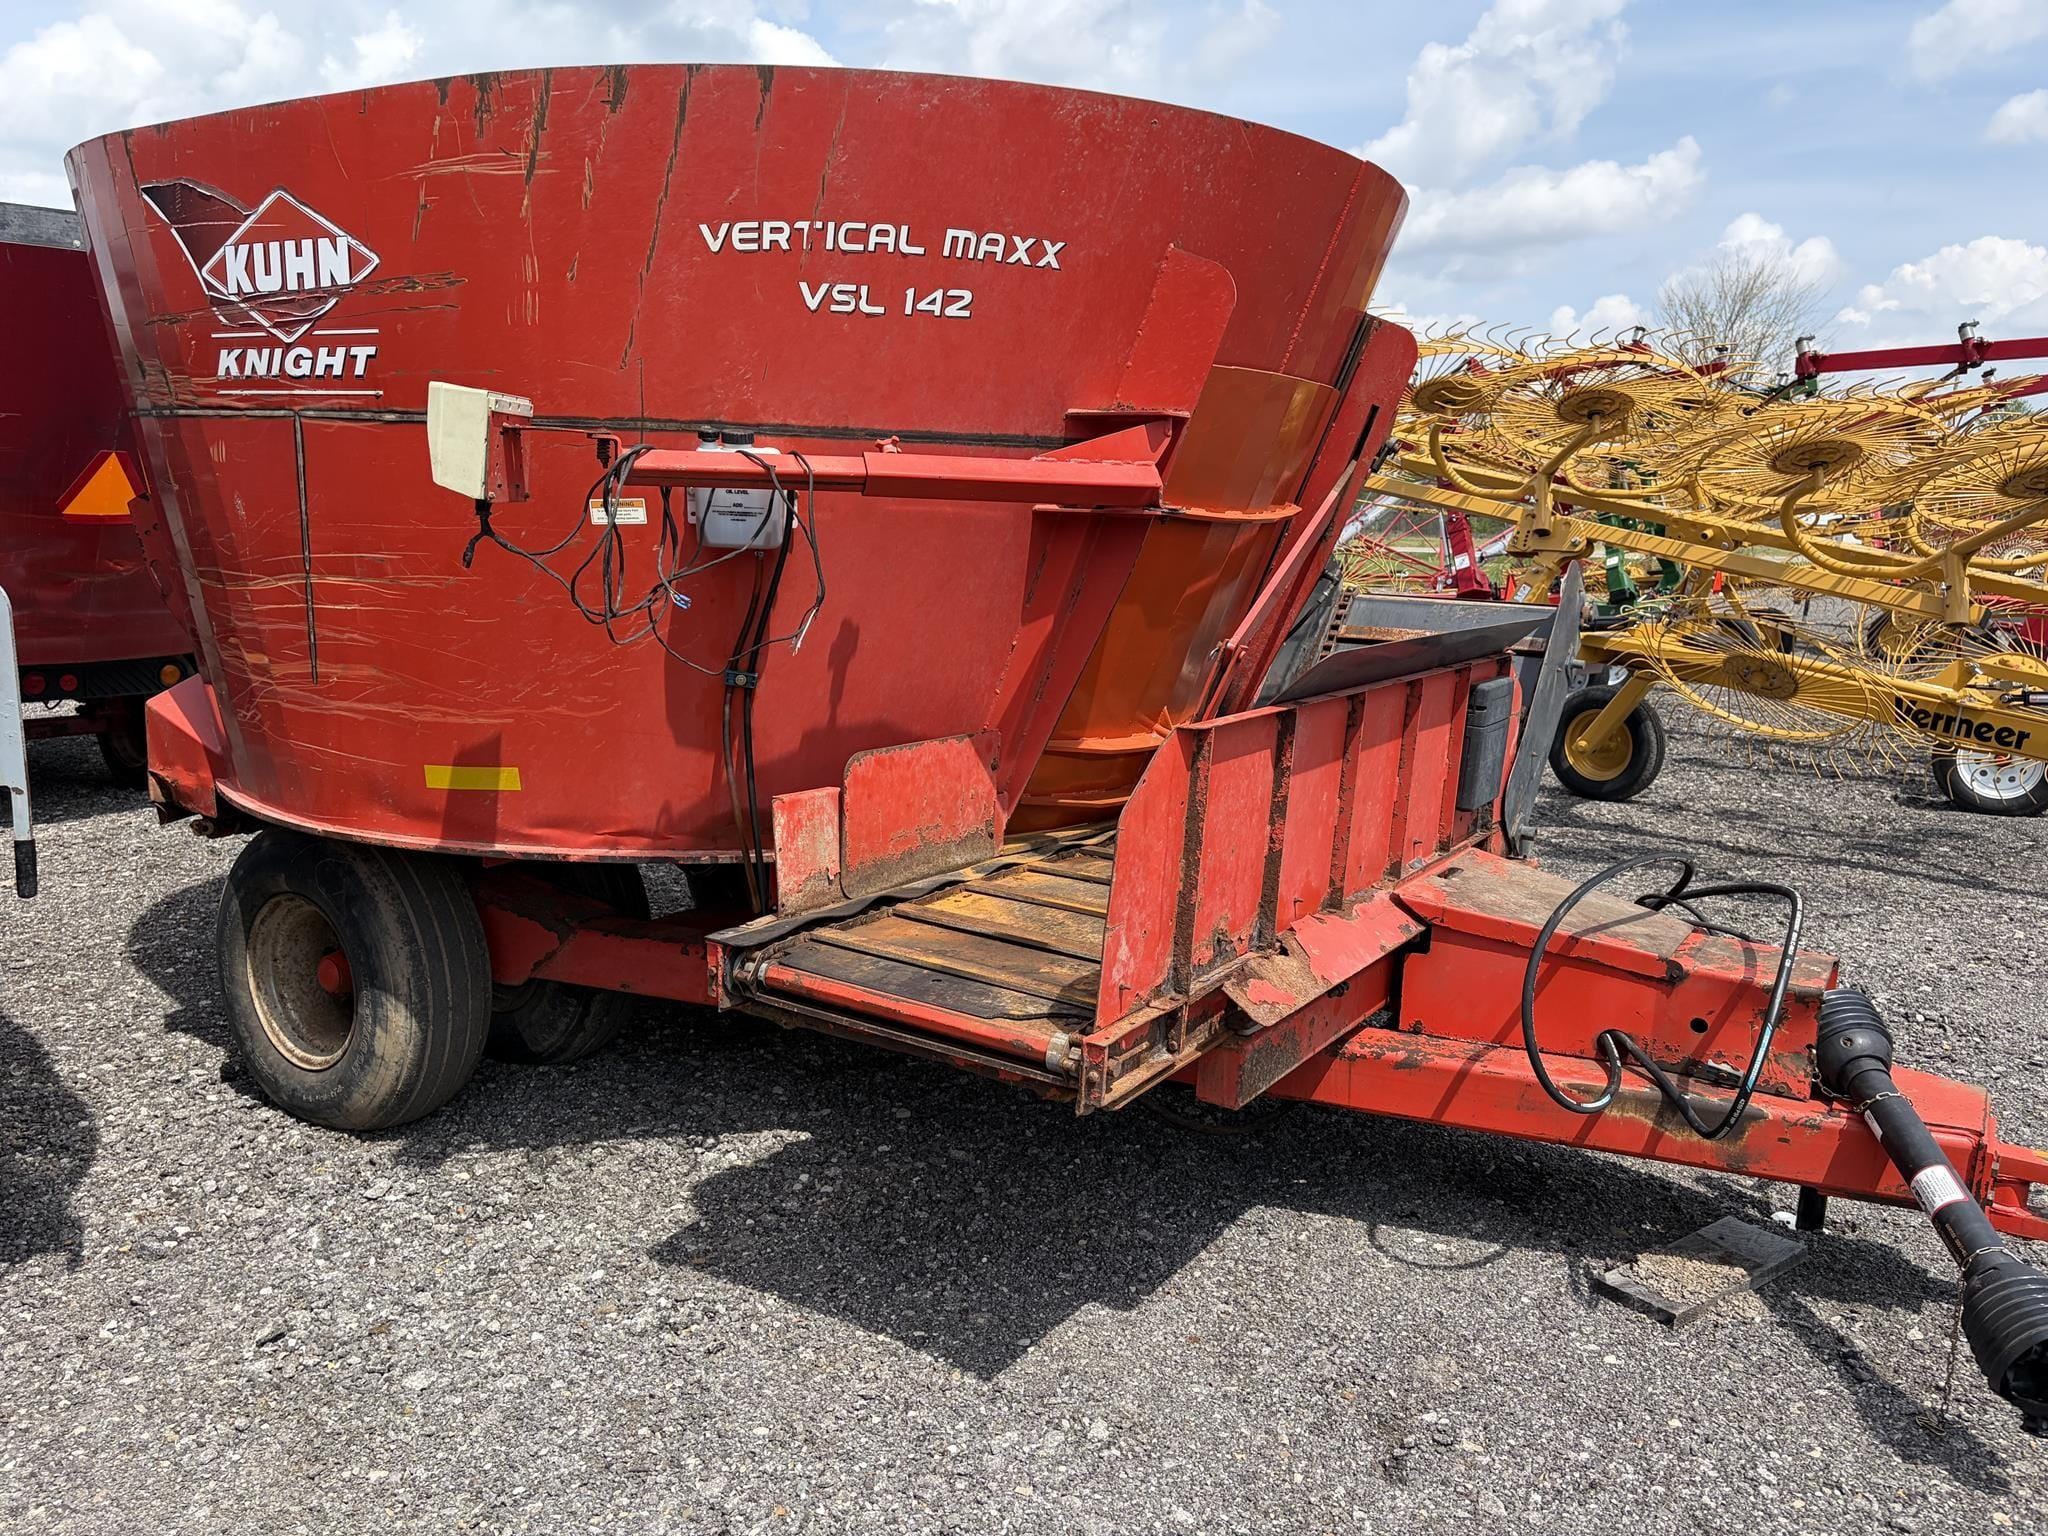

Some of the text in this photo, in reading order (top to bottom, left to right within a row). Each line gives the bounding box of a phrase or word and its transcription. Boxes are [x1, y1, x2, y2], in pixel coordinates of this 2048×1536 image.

[224, 235, 351, 295] KUHN
[698, 220, 1066, 271] VERTICAL MAXX
[798, 281, 974, 318] VSL 142
[216, 345, 378, 380] KNIGHT
[1894, 696, 2031, 750] Vermeer
